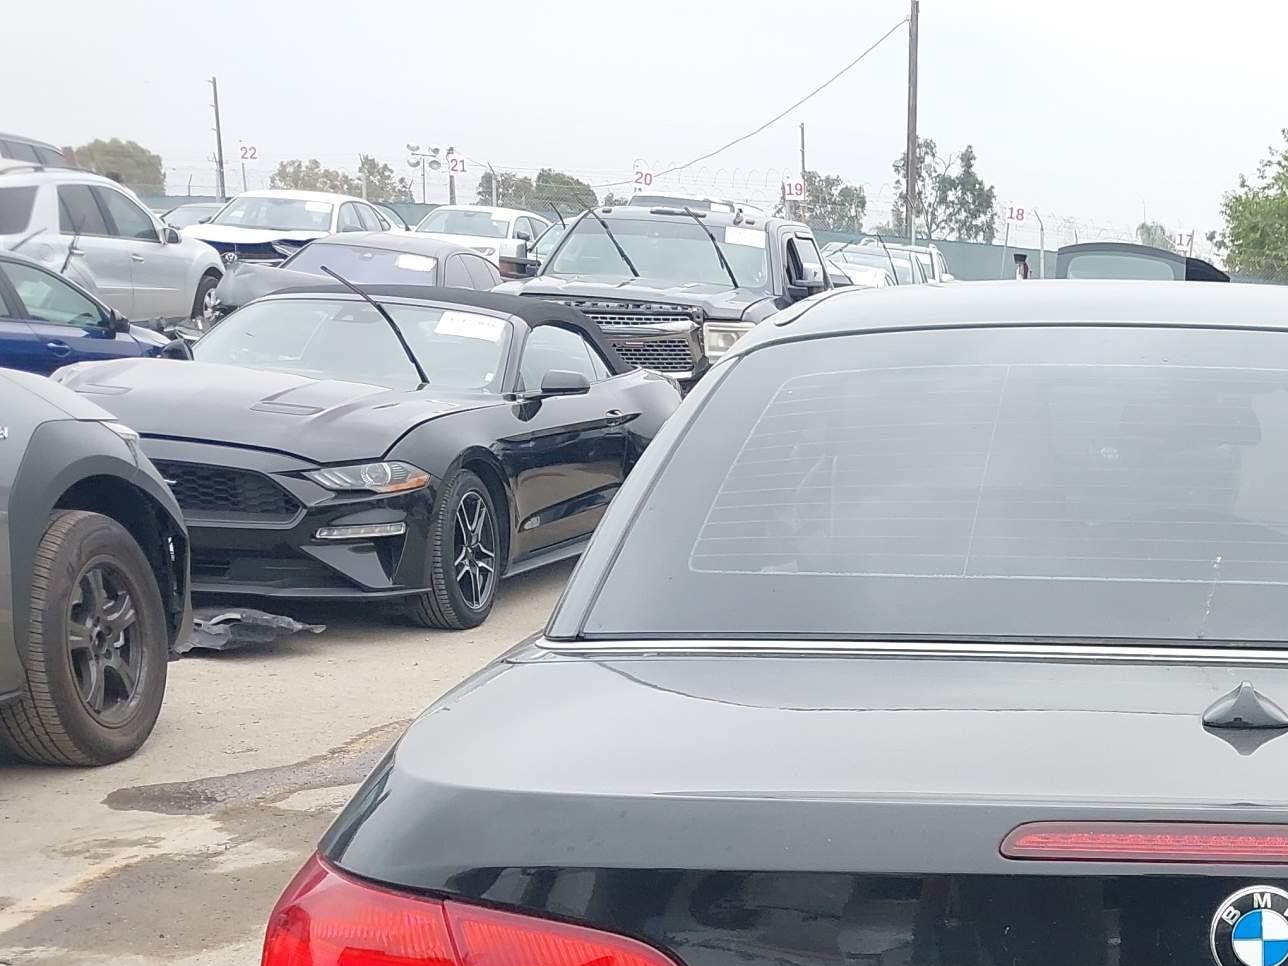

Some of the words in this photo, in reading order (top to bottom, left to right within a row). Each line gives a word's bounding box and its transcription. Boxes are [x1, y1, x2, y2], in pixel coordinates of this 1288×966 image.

[240, 146, 258, 160] 22
[450, 158, 468, 173] 21
[634, 171, 653, 186] 20
[786, 182, 803, 196] 19
[1007, 206, 1025, 221] 18
[1176, 233, 1193, 247] 17
